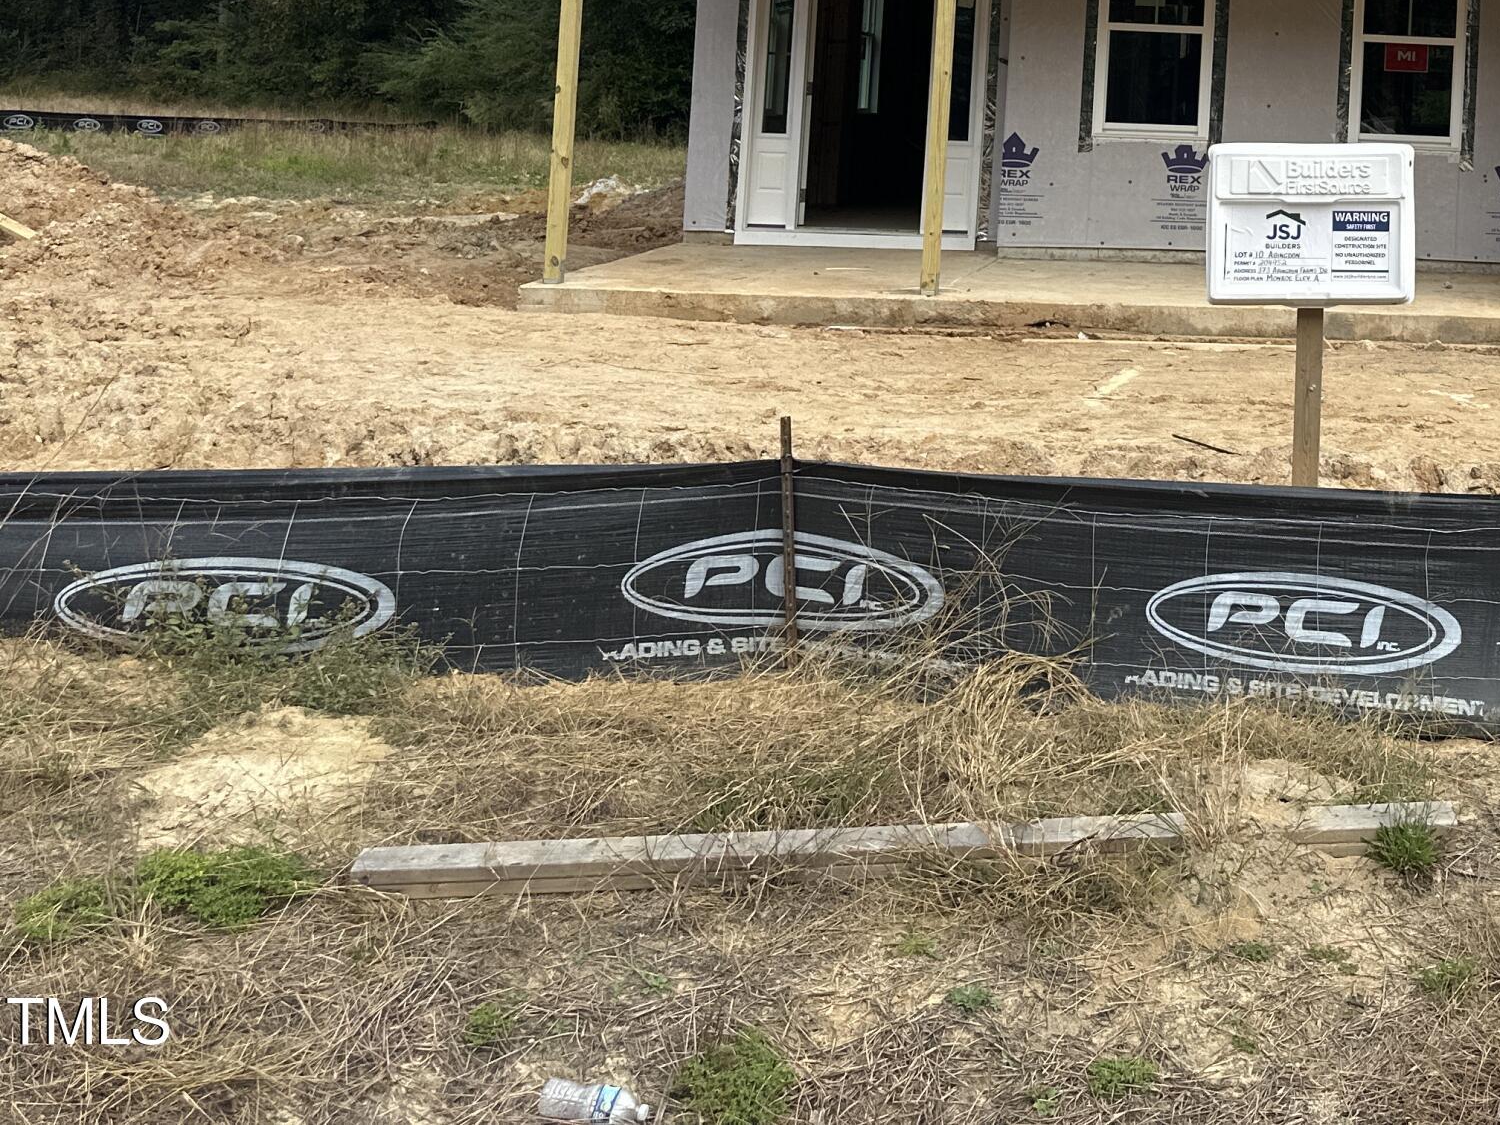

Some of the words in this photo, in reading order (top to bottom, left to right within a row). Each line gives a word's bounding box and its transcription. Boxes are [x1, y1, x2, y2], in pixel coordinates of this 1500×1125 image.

[1397, 50, 1416, 62] MI
[1286, 159, 1371, 179] Builders
[1166, 174, 1202, 185] REX
[1170, 184, 1200, 192] WRAP
[1285, 180, 1371, 196] FirstSource
[1334, 212, 1388, 222] WARNING
[1265, 223, 1302, 240] JSJ
[683, 554, 867, 606] PCI
[1207, 590, 1386, 648] PCI
[706, 637, 728, 655] &
